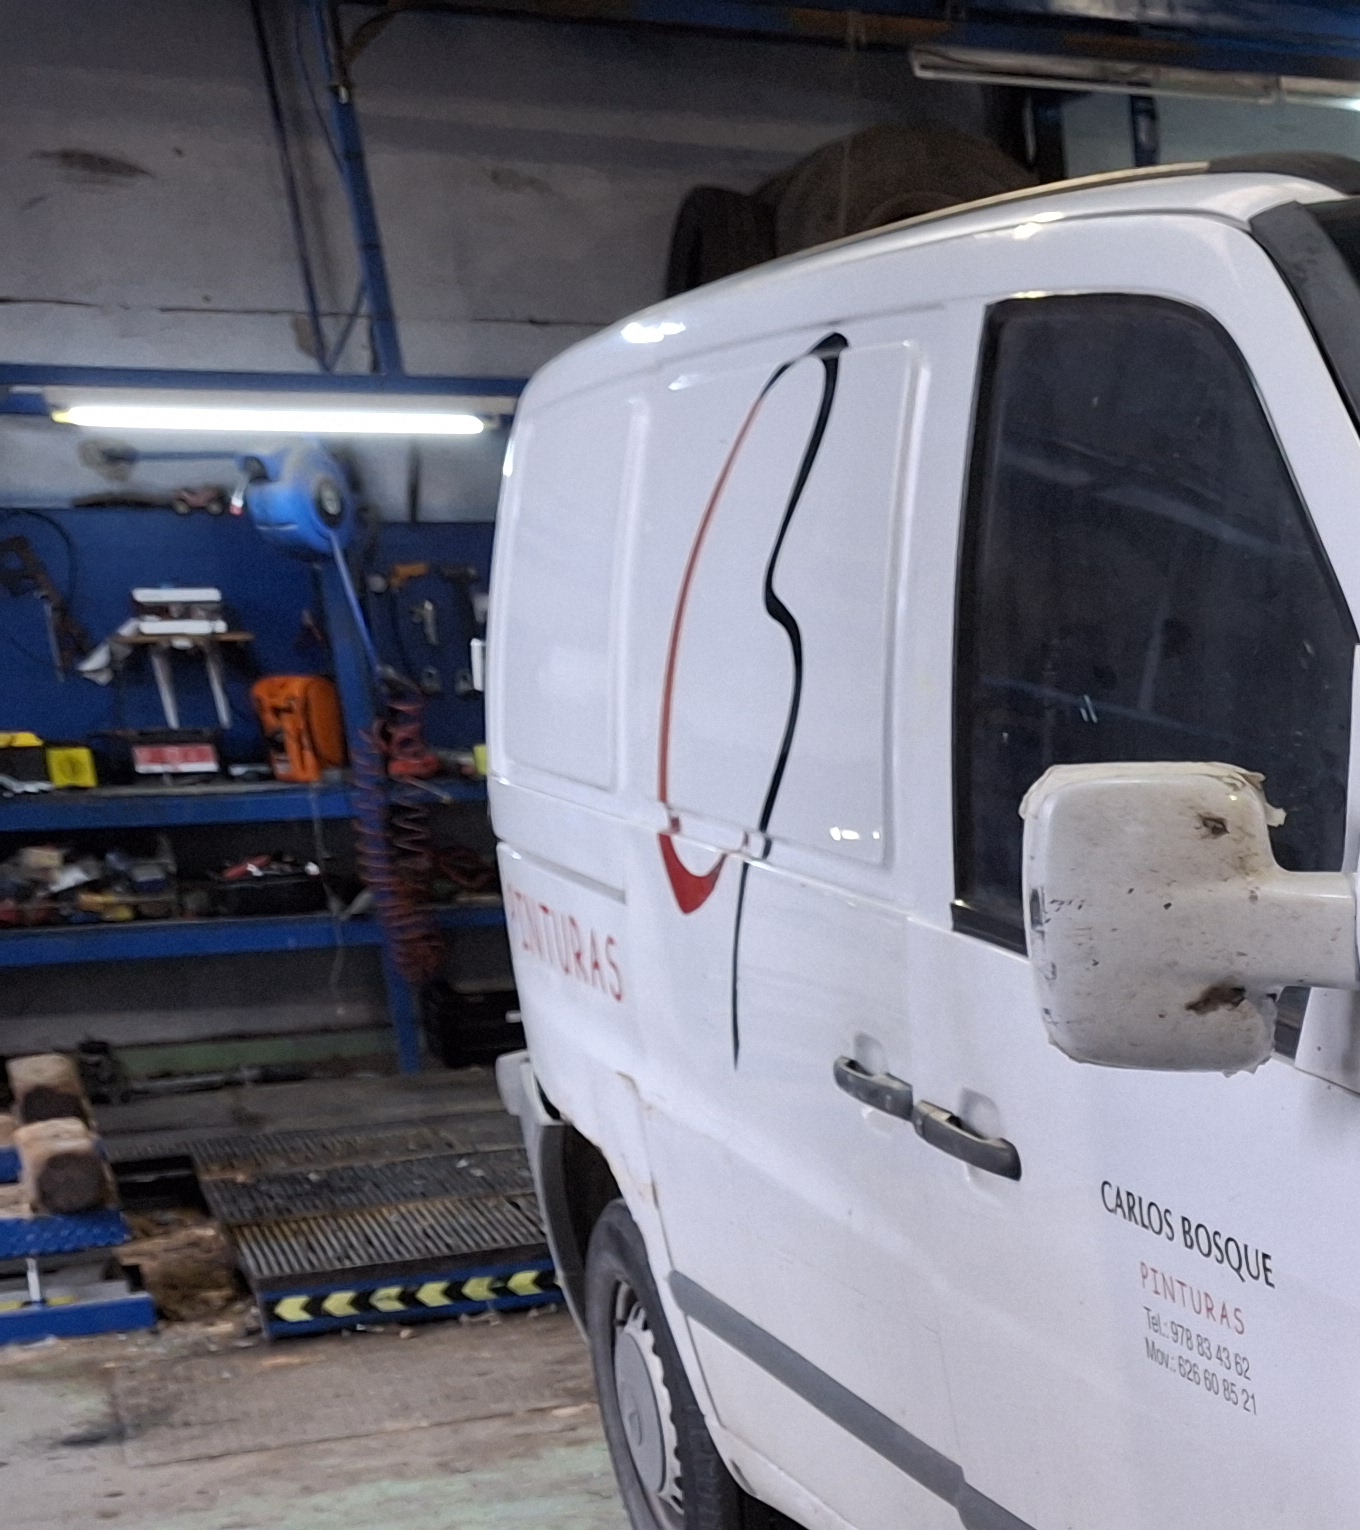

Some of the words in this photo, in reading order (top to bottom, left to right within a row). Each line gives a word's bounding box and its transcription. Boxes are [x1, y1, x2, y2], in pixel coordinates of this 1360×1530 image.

[1100, 1180, 1175, 1242] CARLOS
[1180, 1215, 1275, 1289] BOSQUE
[1139, 1261, 1245, 1336] PINTURAS
[1170, 1320, 1194, 1351] 978
[1196, 1333, 1213, 1361] 83
[1215, 1344, 1232, 1371] 43
[1234, 1352, 1251, 1381] 62
[1178, 1355, 1201, 1385] 626
[1203, 1368, 1220, 1396] 60
[1222, 1378, 1239, 1406] 85
[1241, 1388, 1257, 1416] 21
